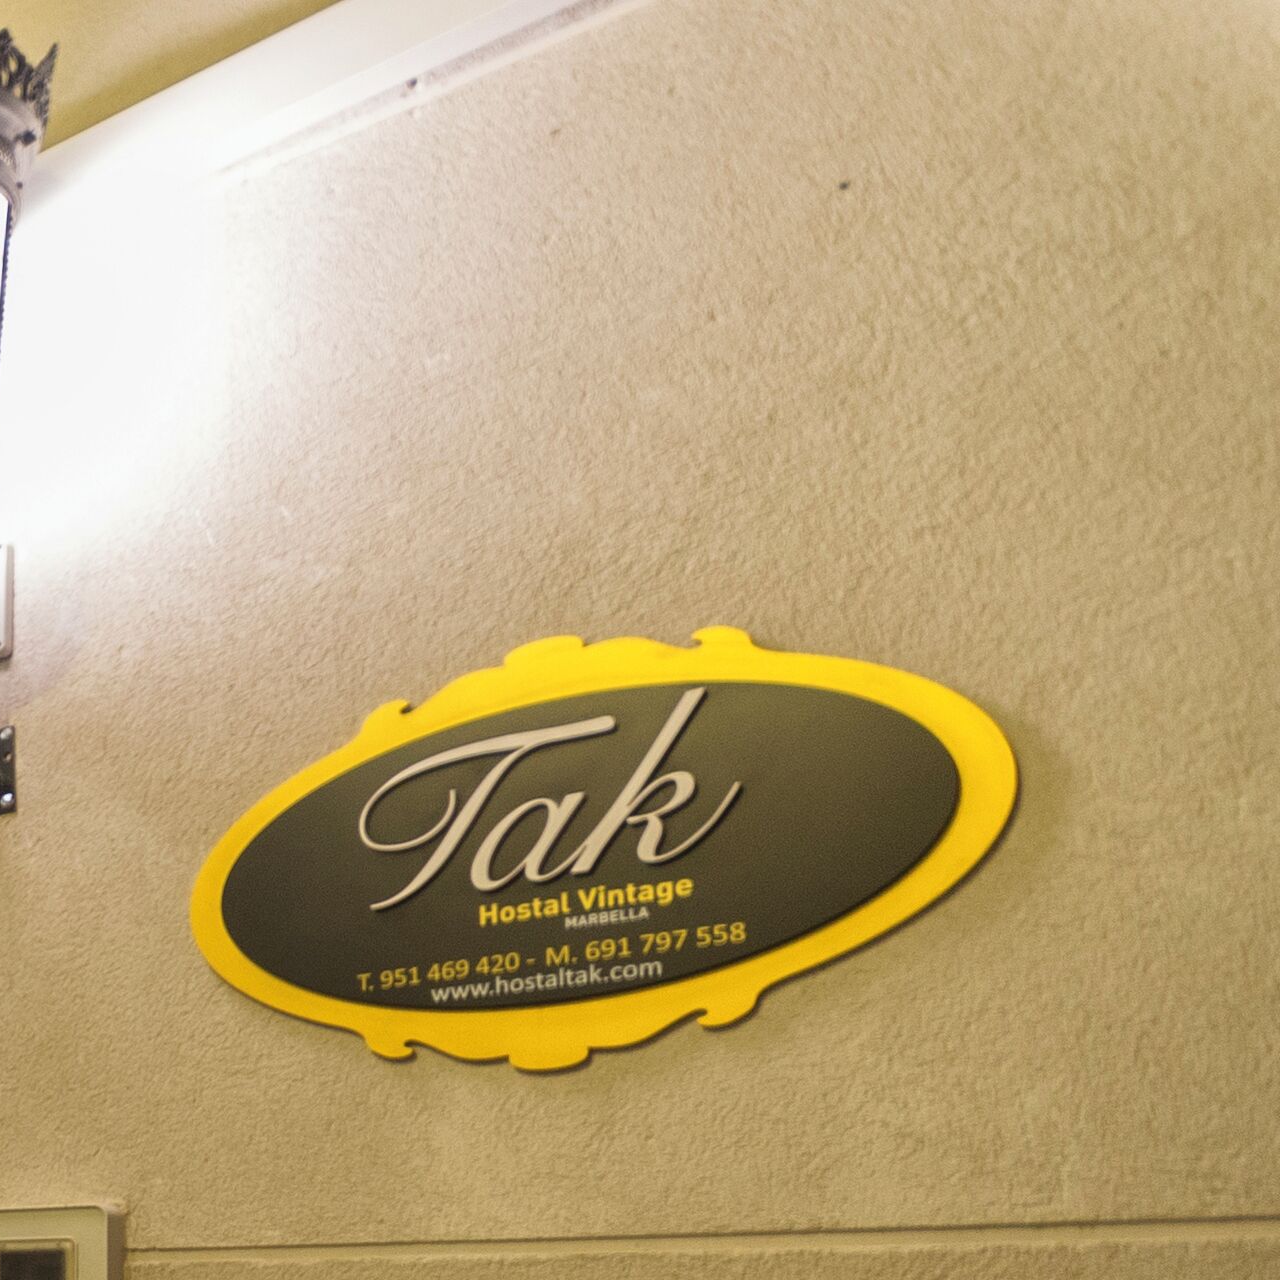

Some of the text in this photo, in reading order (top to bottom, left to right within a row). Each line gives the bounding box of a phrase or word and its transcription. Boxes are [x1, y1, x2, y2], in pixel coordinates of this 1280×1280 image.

[358, 687, 743, 911] Tak
[479, 877, 694, 927] Hostal Vintage
[564, 906, 650, 930] MARBELLA
[356, 972, 375, 993] T.
[380, 966, 421, 990] 951
[427, 959, 469, 983] 469
[475, 951, 521, 977] 420
[545, 945, 577, 969] M.
[585, 937, 632, 961] 691
[640, 929, 688, 954] 797
[696, 921, 747, 948] 558
[430, 958, 664, 1003] www.hostaltak.com
